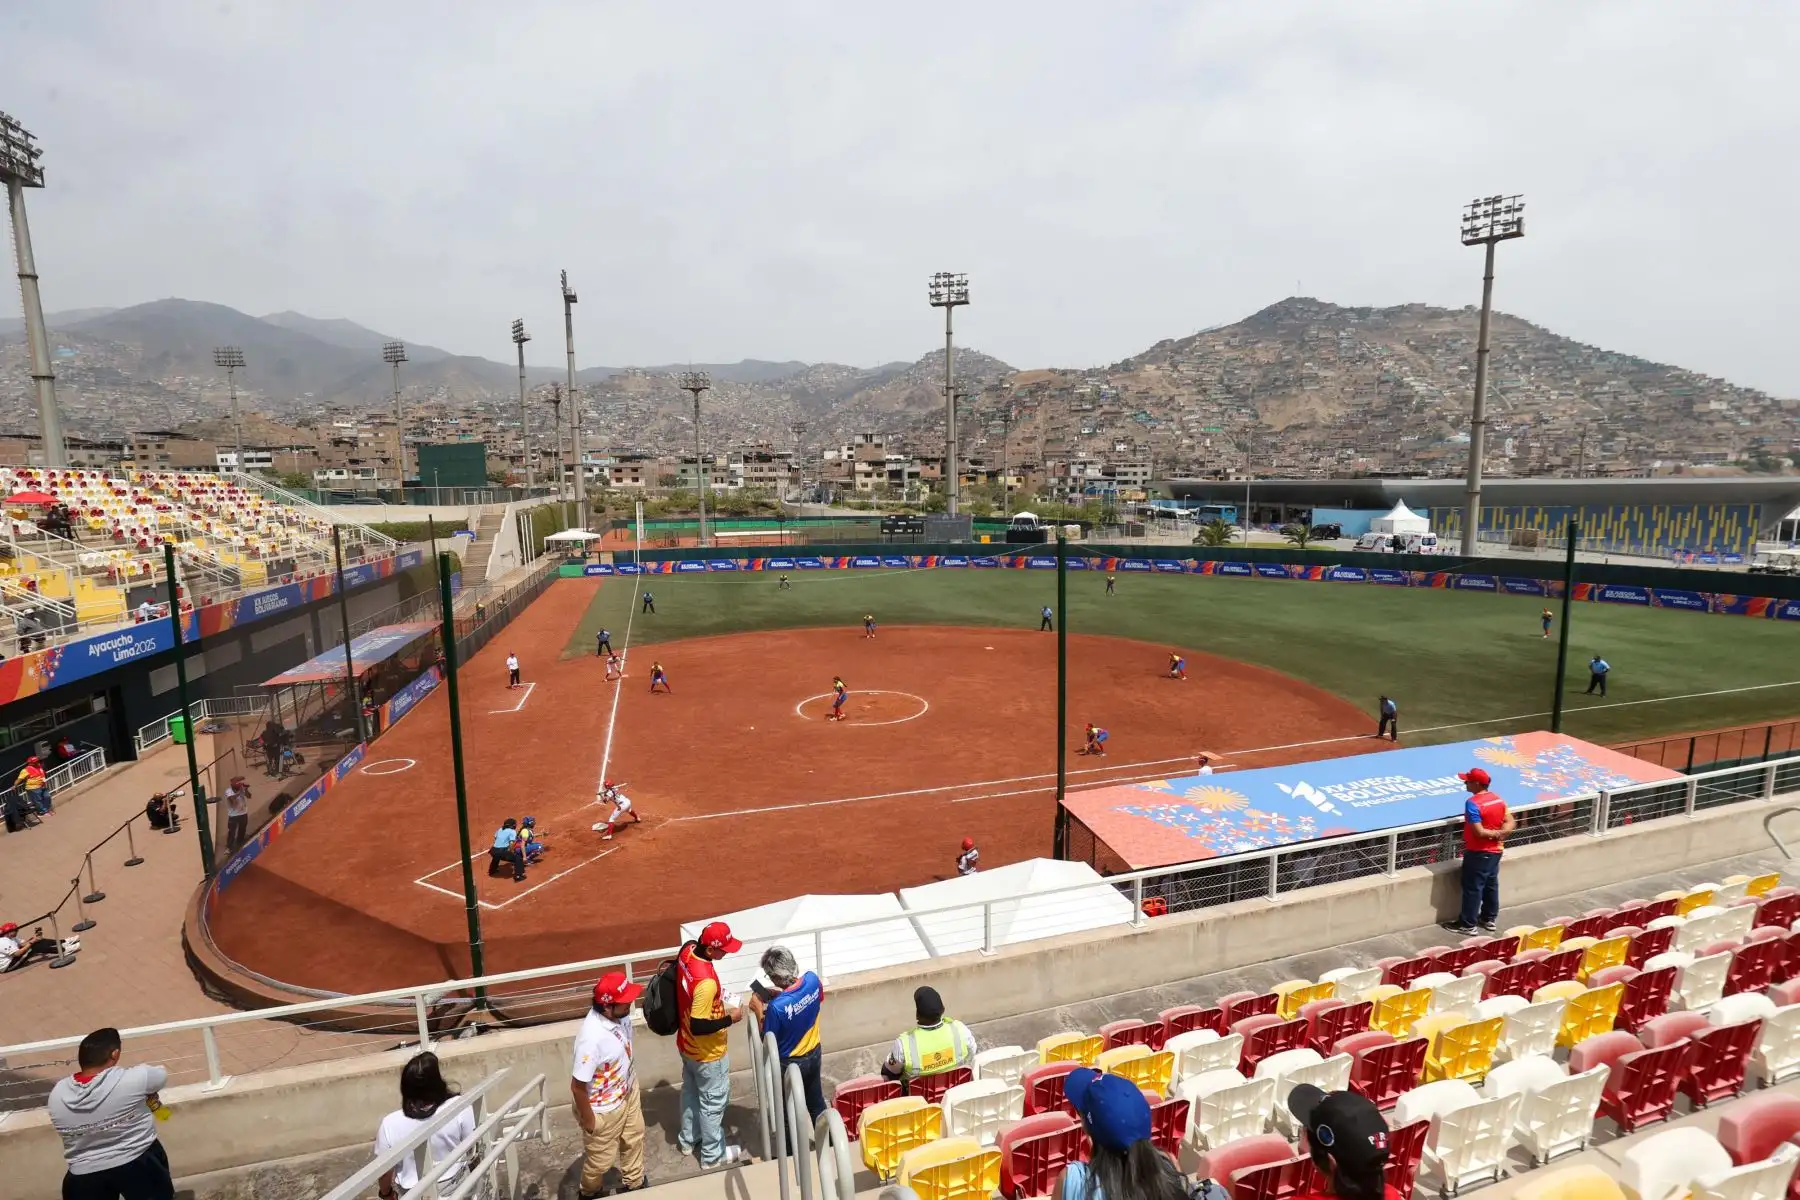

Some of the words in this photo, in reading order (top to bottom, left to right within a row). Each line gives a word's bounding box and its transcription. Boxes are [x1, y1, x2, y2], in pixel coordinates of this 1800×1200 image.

[88, 633, 134, 657] Ayacucho
[1332, 776, 1464, 803] BOLIVARIAN
[1345, 775, 1412, 791] JUEGOS
[923, 1058, 954, 1071] PROSEGUR
